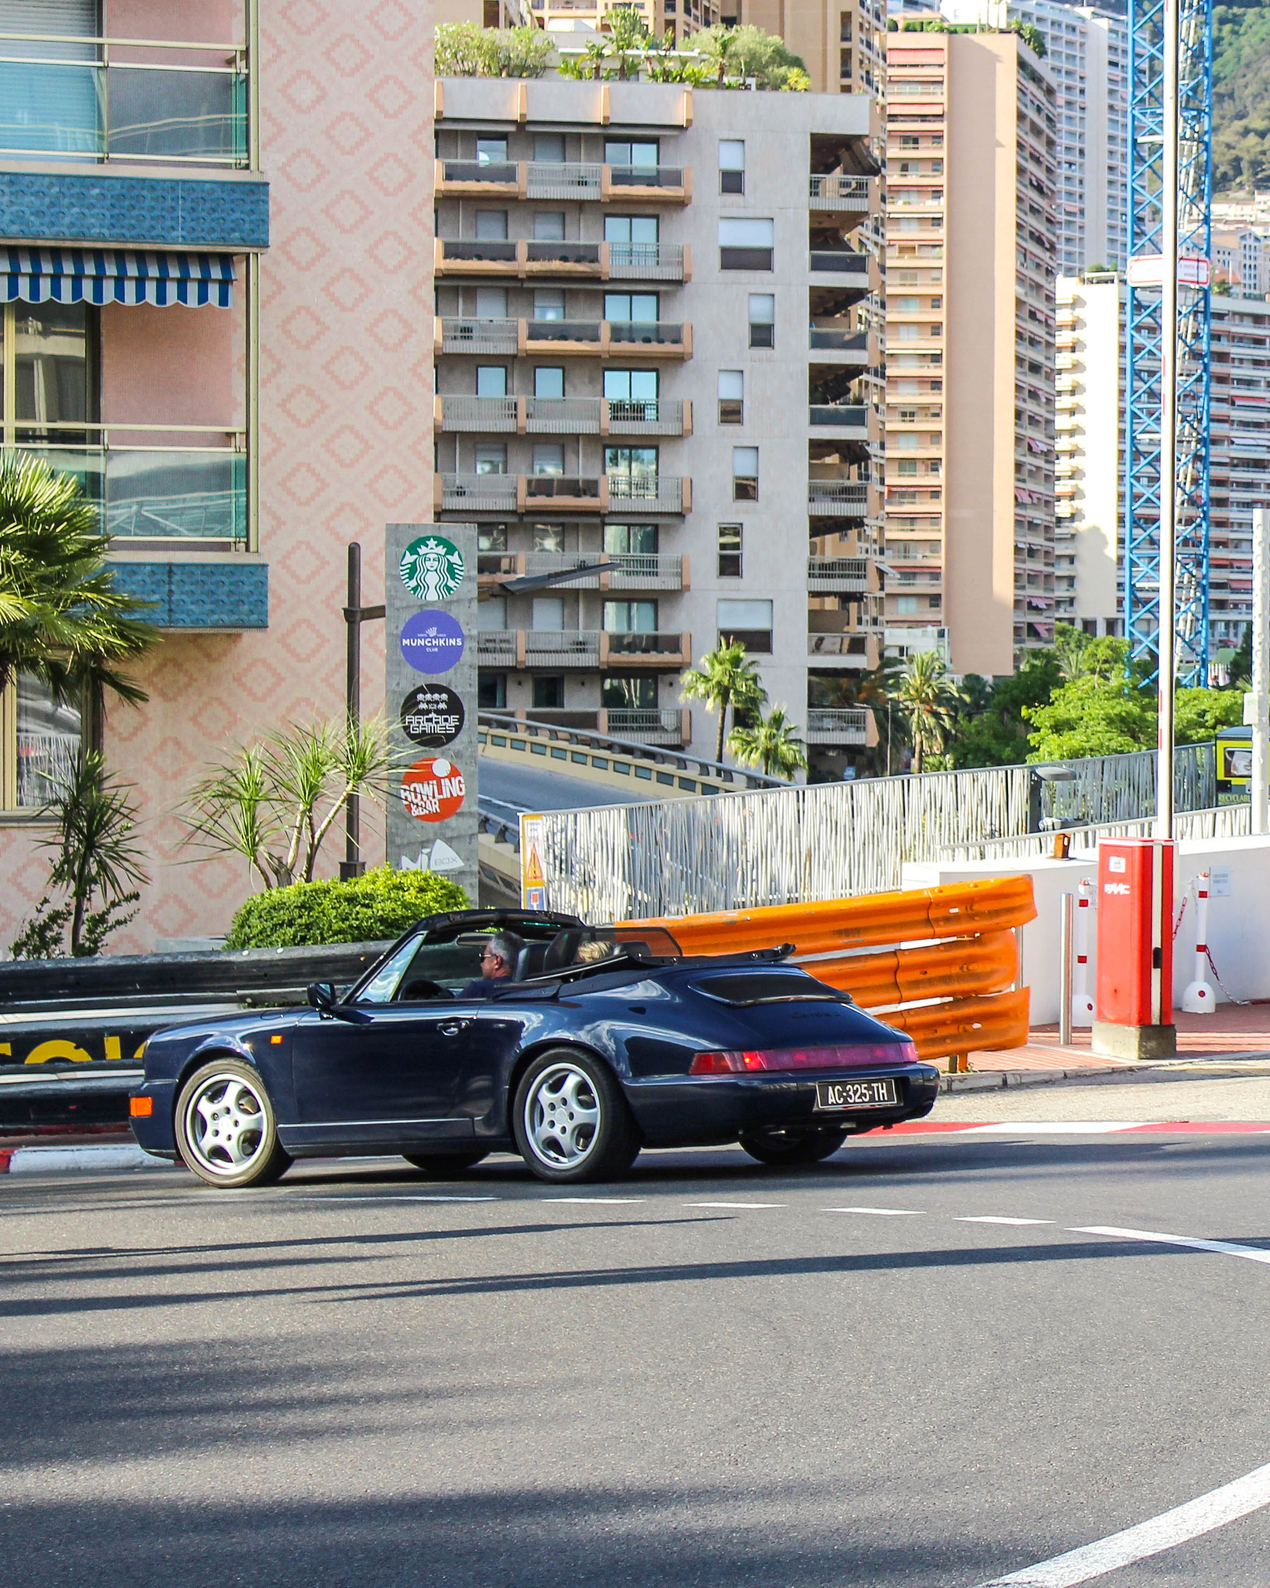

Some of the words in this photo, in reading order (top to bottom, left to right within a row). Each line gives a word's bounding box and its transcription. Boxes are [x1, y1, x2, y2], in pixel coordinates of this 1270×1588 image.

[402, 638, 463, 647] MUNCHKINS
[405, 715, 460, 726] ARCADE
[410, 724, 456, 734] GAMES
[400, 776, 465, 805] BOWLING
[411, 799, 440, 817] &BAR
[435, 857, 458, 866] BOX
